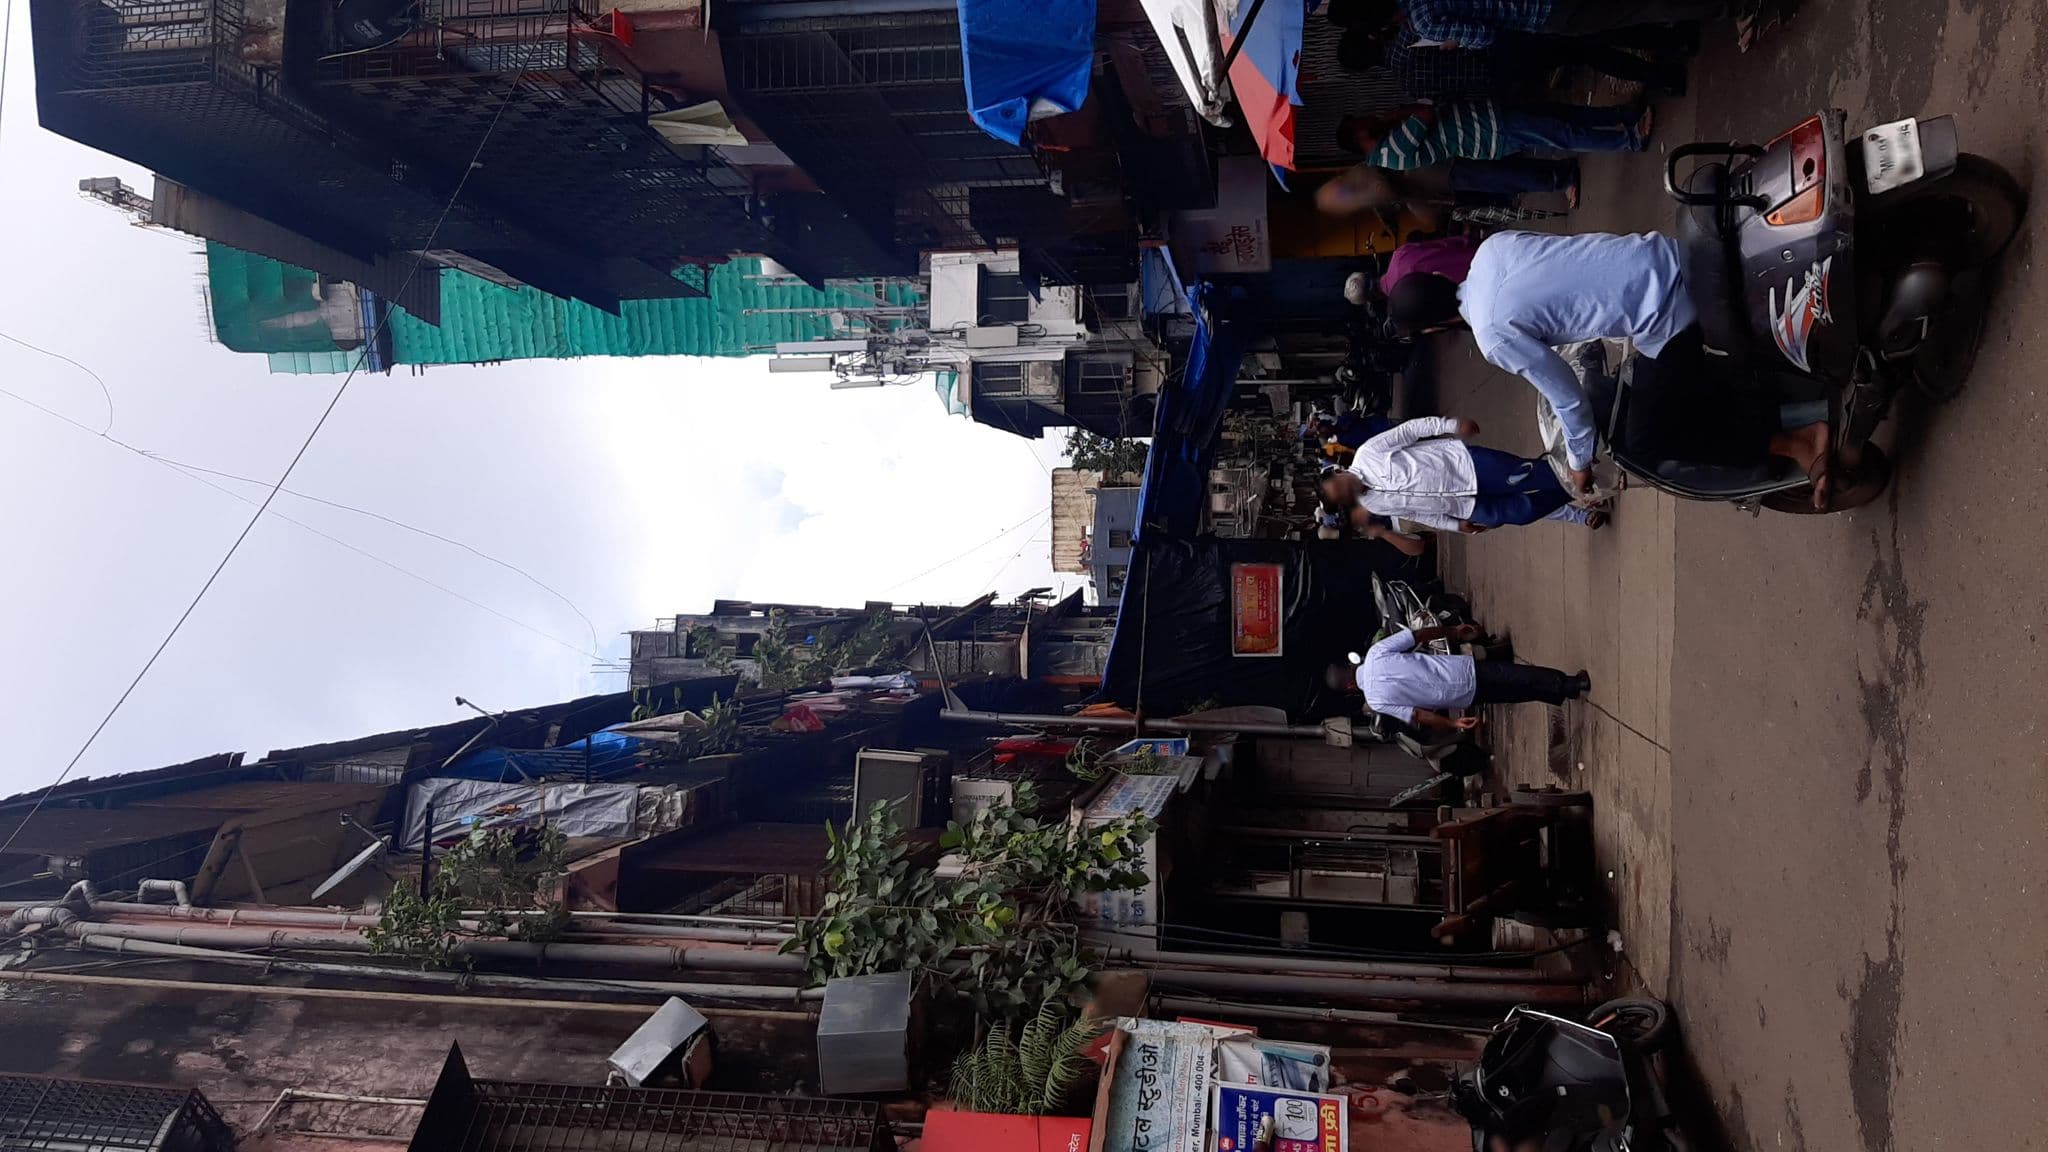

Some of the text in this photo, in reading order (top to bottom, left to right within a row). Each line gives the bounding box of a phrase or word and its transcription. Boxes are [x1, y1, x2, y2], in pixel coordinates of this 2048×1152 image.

[1810, 261, 1824, 320] Activa
[1285, 1100, 1304, 1120] 100
[1132, 1117, 1152, 1152] टल
